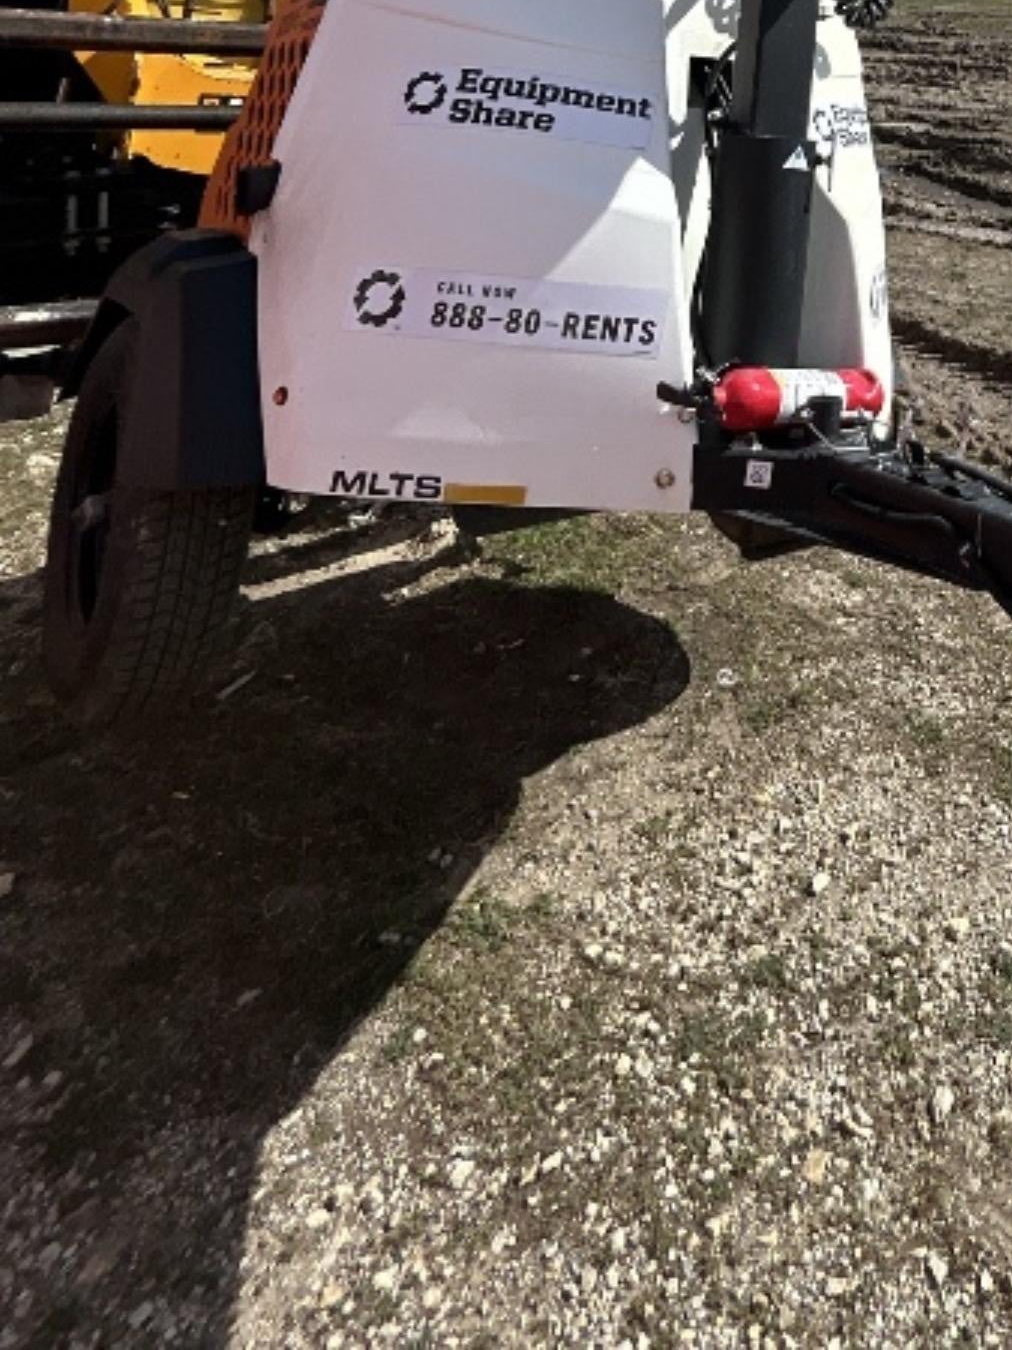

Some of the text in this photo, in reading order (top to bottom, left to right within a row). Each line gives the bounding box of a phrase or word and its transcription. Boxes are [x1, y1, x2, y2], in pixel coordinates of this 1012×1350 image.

[454, 68, 653, 120] Equipment
[447, 97, 556, 133] Share
[435, 280, 518, 301] CALL NOW
[430, 301, 658, 346] 888-80-RENTS
[328, 470, 443, 500] MLTS
